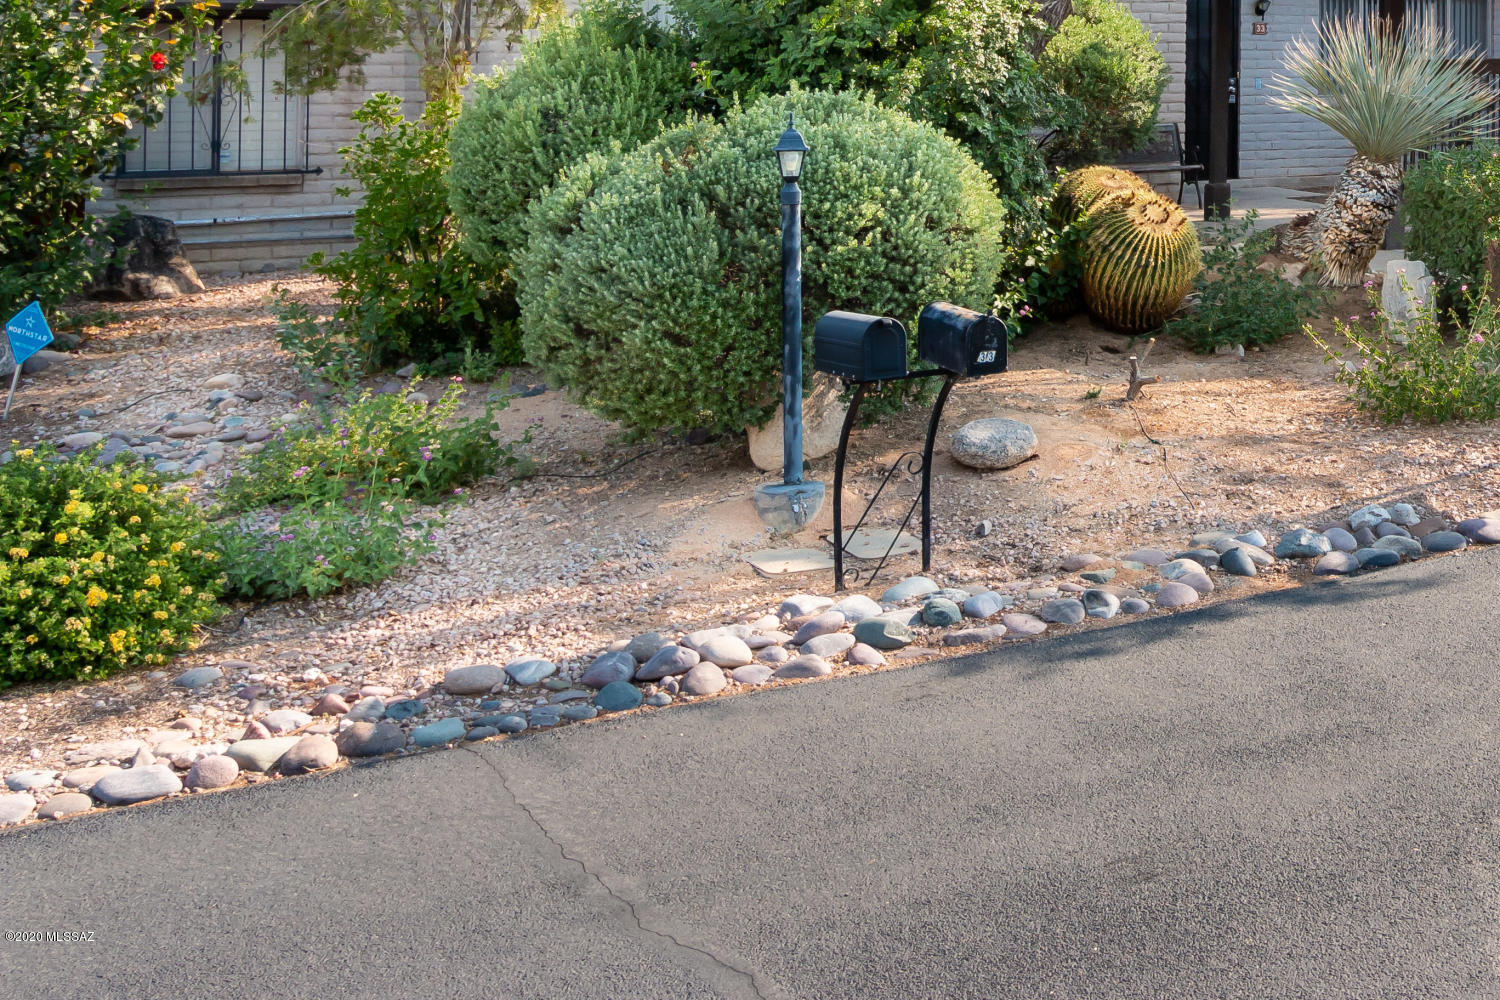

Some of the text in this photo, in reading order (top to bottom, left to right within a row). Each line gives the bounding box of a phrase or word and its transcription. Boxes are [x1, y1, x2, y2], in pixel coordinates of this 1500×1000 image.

[1256, 24, 1265, 33] 33
[8, 325, 48, 342] NORTHSTAR
[980, 351, 994, 362] 33
